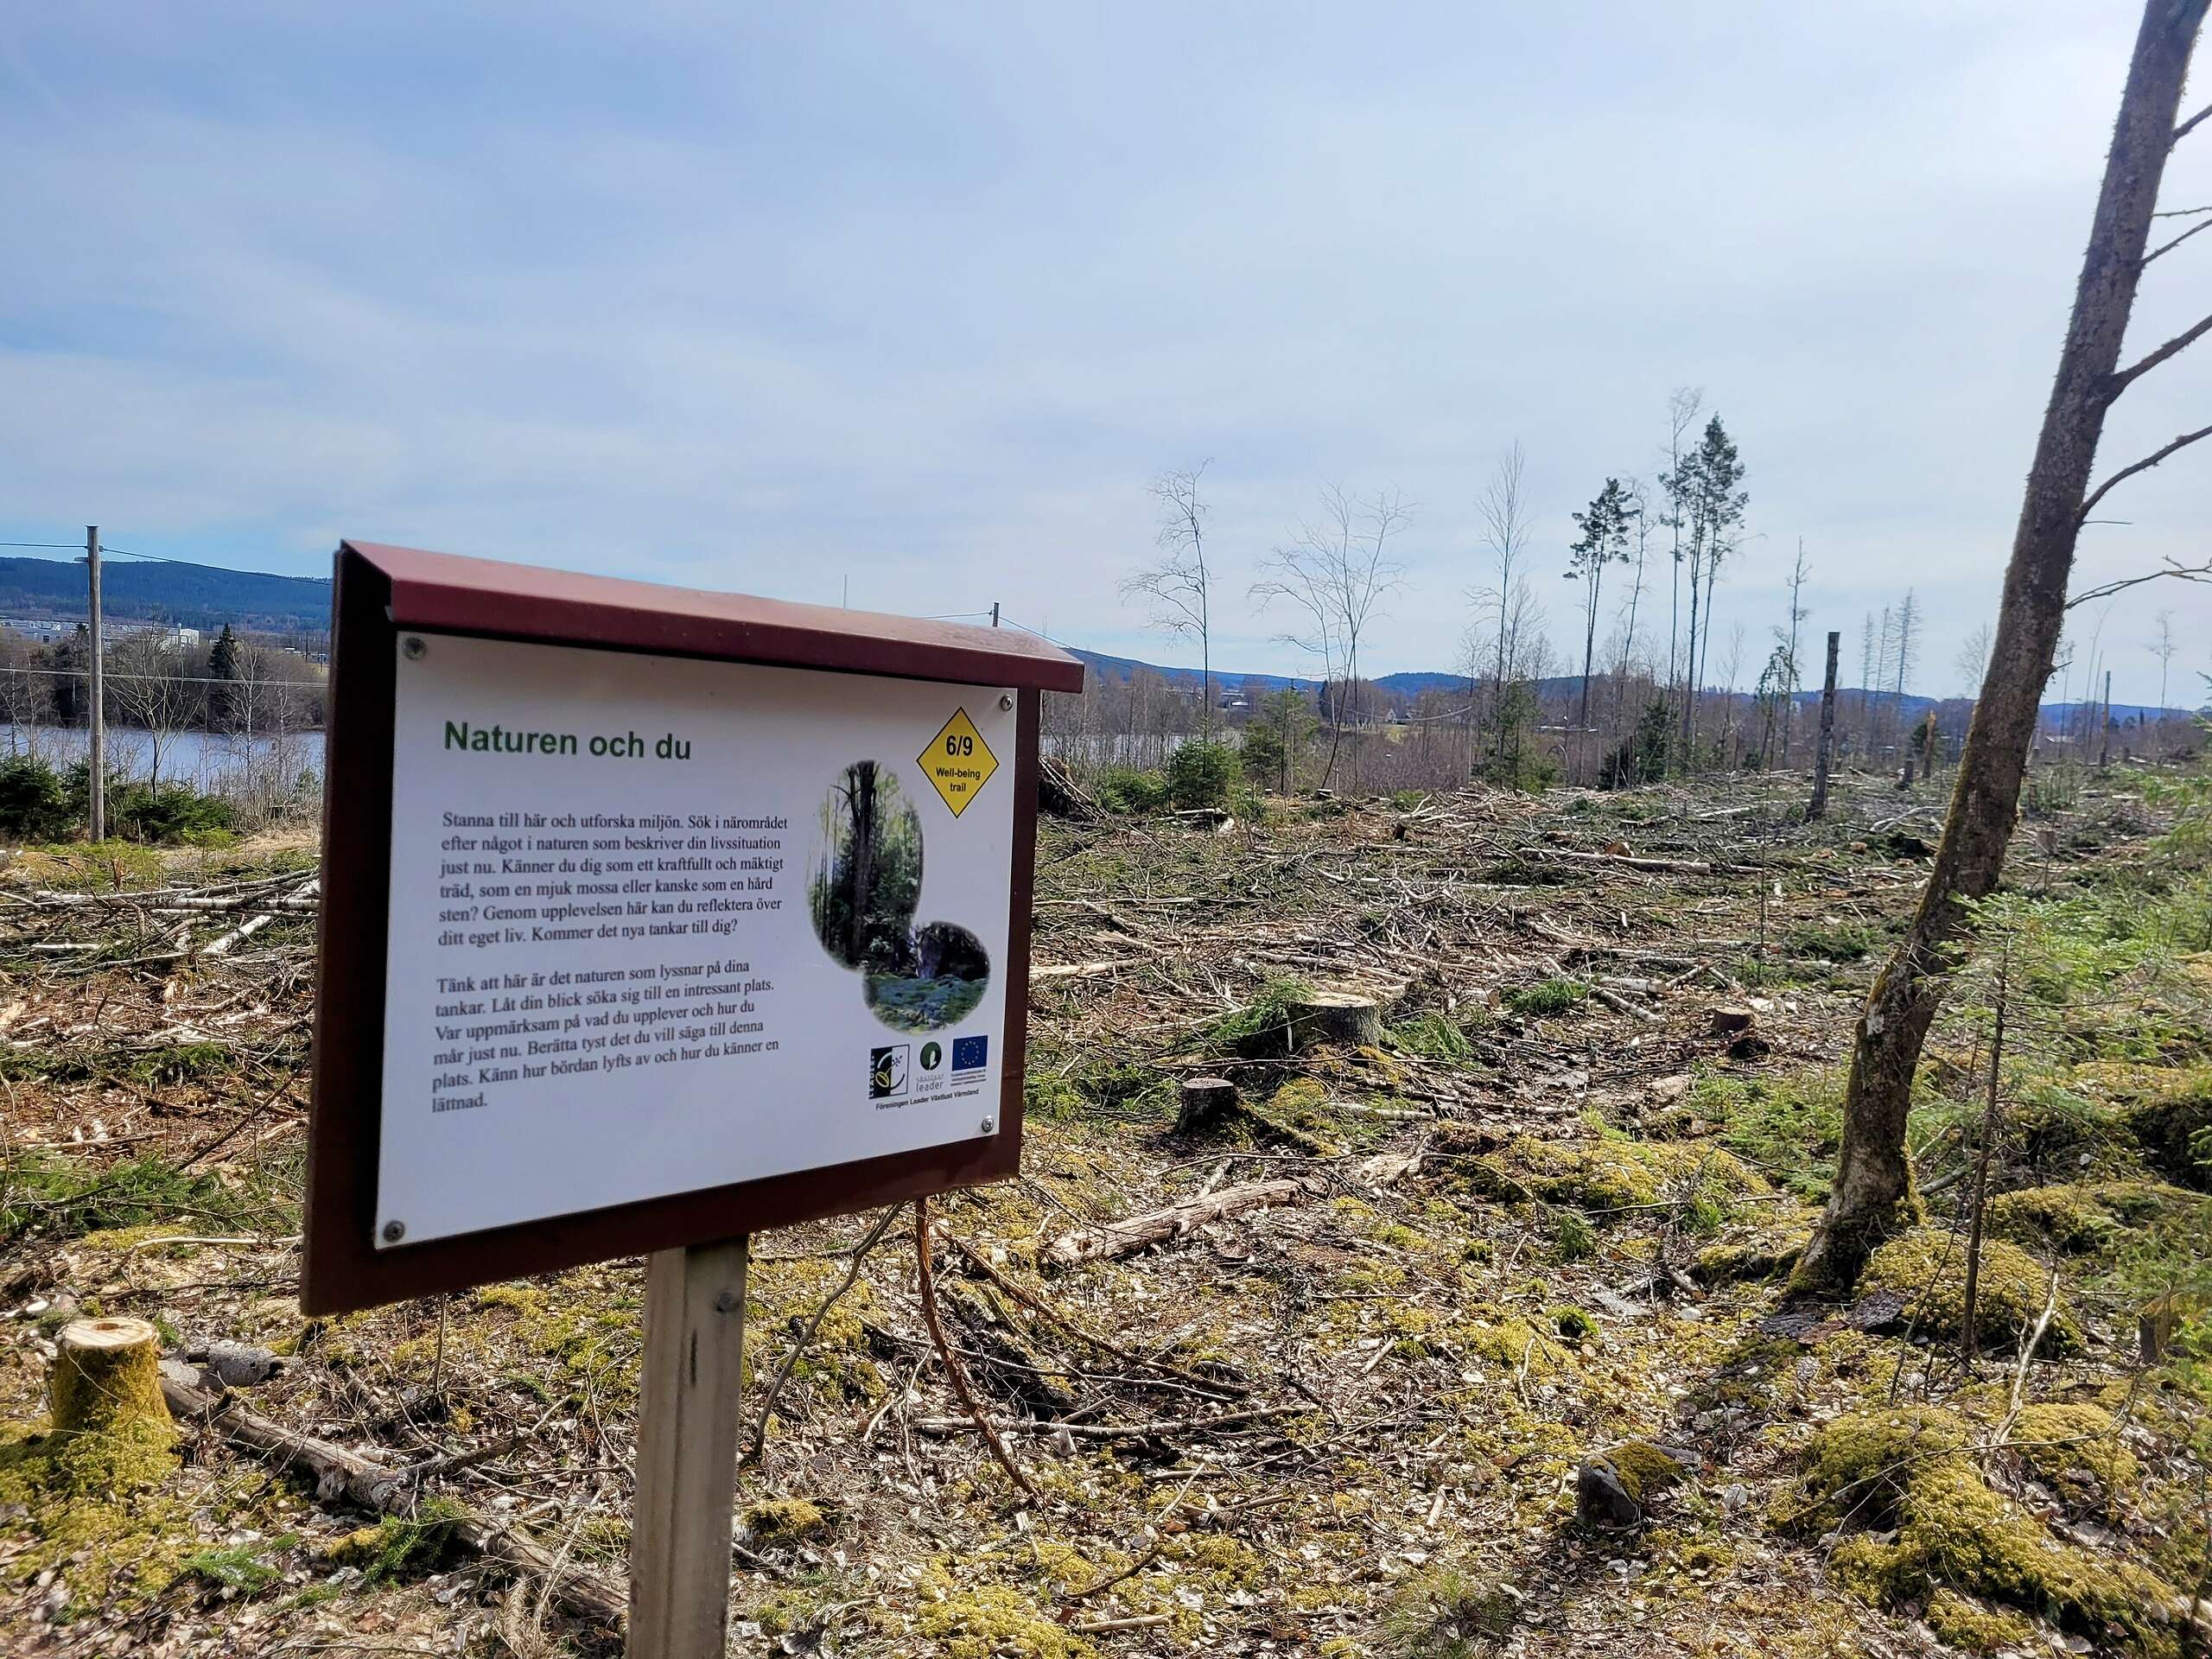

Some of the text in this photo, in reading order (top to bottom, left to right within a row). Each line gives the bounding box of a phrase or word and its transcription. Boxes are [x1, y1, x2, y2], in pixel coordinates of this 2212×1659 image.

[444, 721, 691, 760] Naturen och du
[946, 735, 973, 756] 6/9
[936, 767, 981, 780] Well-being
[950, 783, 966, 791] trail
[442, 811, 788, 832] Stanna till här och utforska miljön. Sök i närområdet
[441, 836, 781, 855] efter något i naturen som beskriver din livssituation
[439, 857, 784, 879] just nu. Känner du dig som ett kraftfullt och mäktigt
[440, 876, 773, 899] träd, som en mjuk mossa eller kanske som en hård
[439, 898, 782, 922] sten? Genom upplevelsen här kan du reflektera över
[437, 918, 737, 948] ditt eget liv. Kommer det nya tankar till dig?
[436, 960, 749, 993] Tänk att här är det naturen som lyssnar på dina
[435, 979, 774, 1017] tankar. Låt din blick söka sig till en intressant plats.
[435, 1000, 754, 1041] Var uppmärksam på vad du upplever och hur du
[434, 1021, 764, 1065] mår just nu. Berätta tyst det du vill säga till denna
[432, 1040, 779, 1093] plats. Känn hur bördan lyfts av och hur du känner en
[916, 1081, 944, 1092] leader
[432, 1092, 487, 1113] lättnad.
